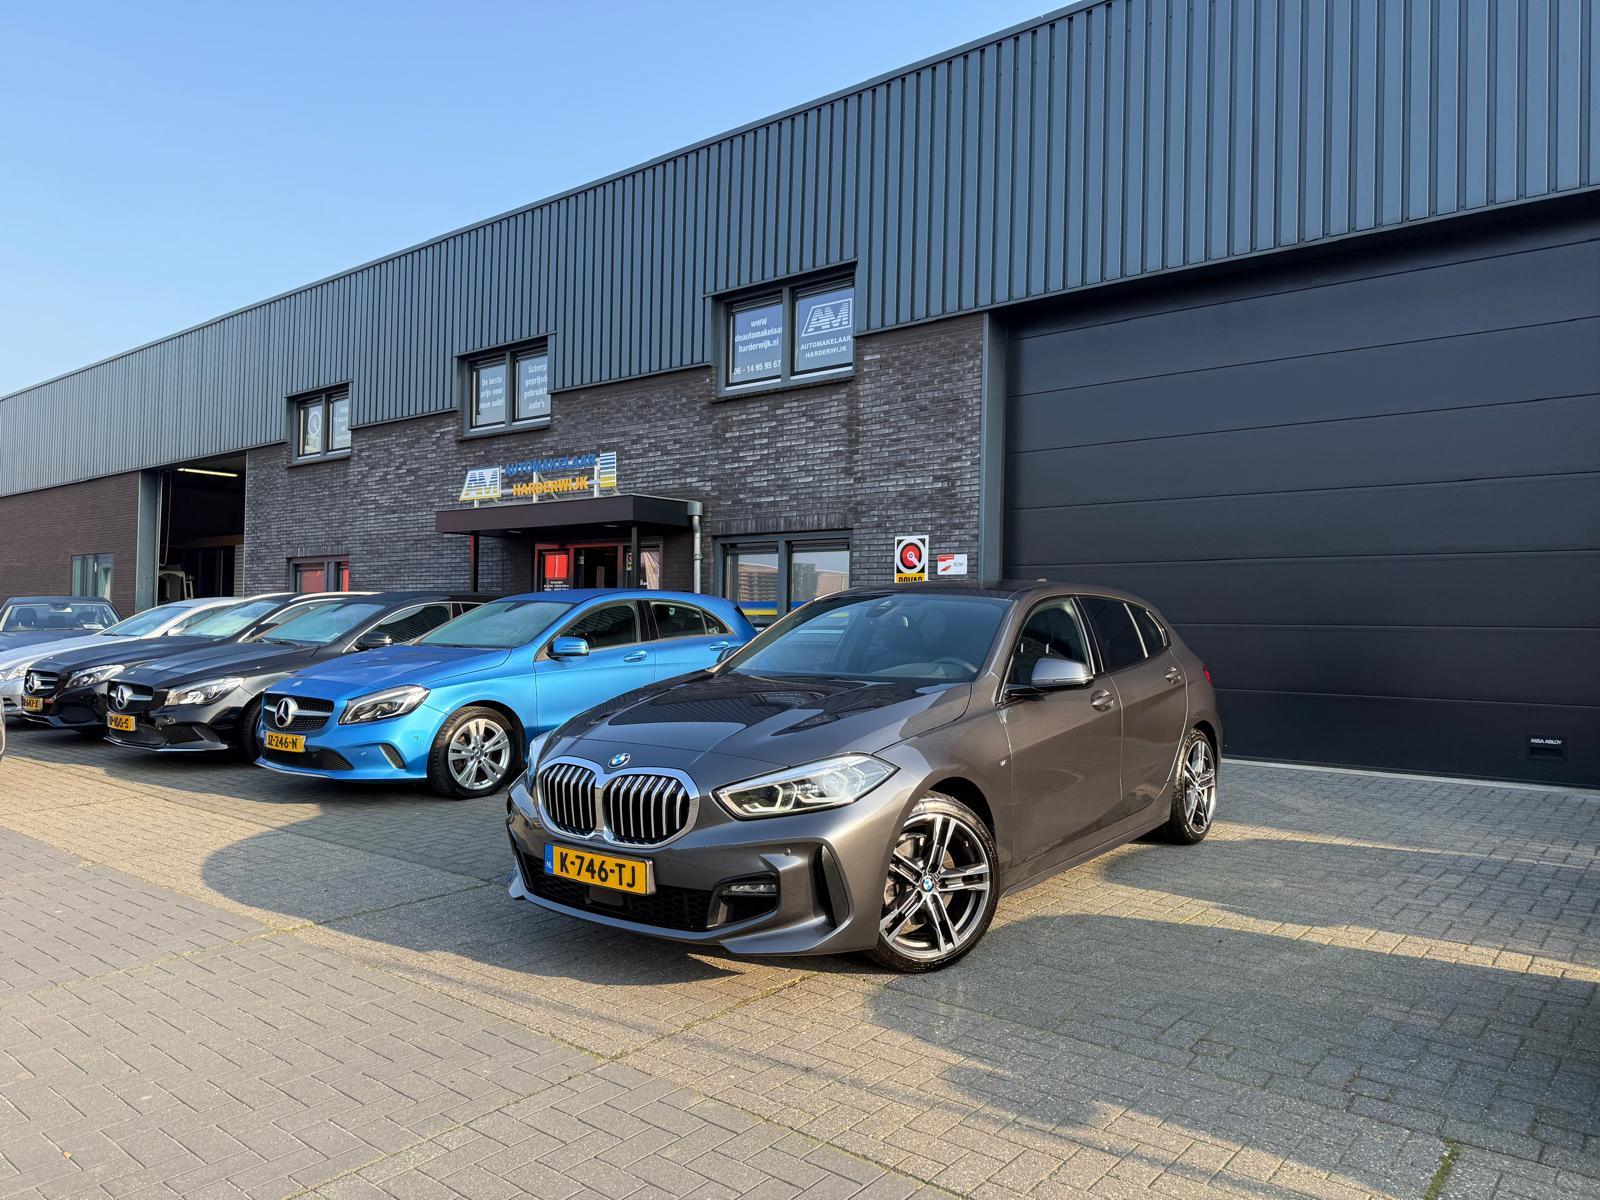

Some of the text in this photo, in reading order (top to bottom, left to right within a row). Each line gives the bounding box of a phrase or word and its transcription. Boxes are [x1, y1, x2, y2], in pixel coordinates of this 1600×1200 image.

[750, 318, 767, 327] www
[739, 337, 779, 352] harderwijk.nl
[800, 335, 852, 351] AUTOMAKELAAR
[805, 345, 847, 358] HARDERWIJK
[747, 365, 754, 373] 14
[764, 361, 772, 370] 95
[528, 399, 545, 410] auto's
[504, 453, 597, 478] AUTOMAKELAAR
[513, 475, 588, 496] HARDERWIJK
[559, 851, 636, 888] K-746-TJ
